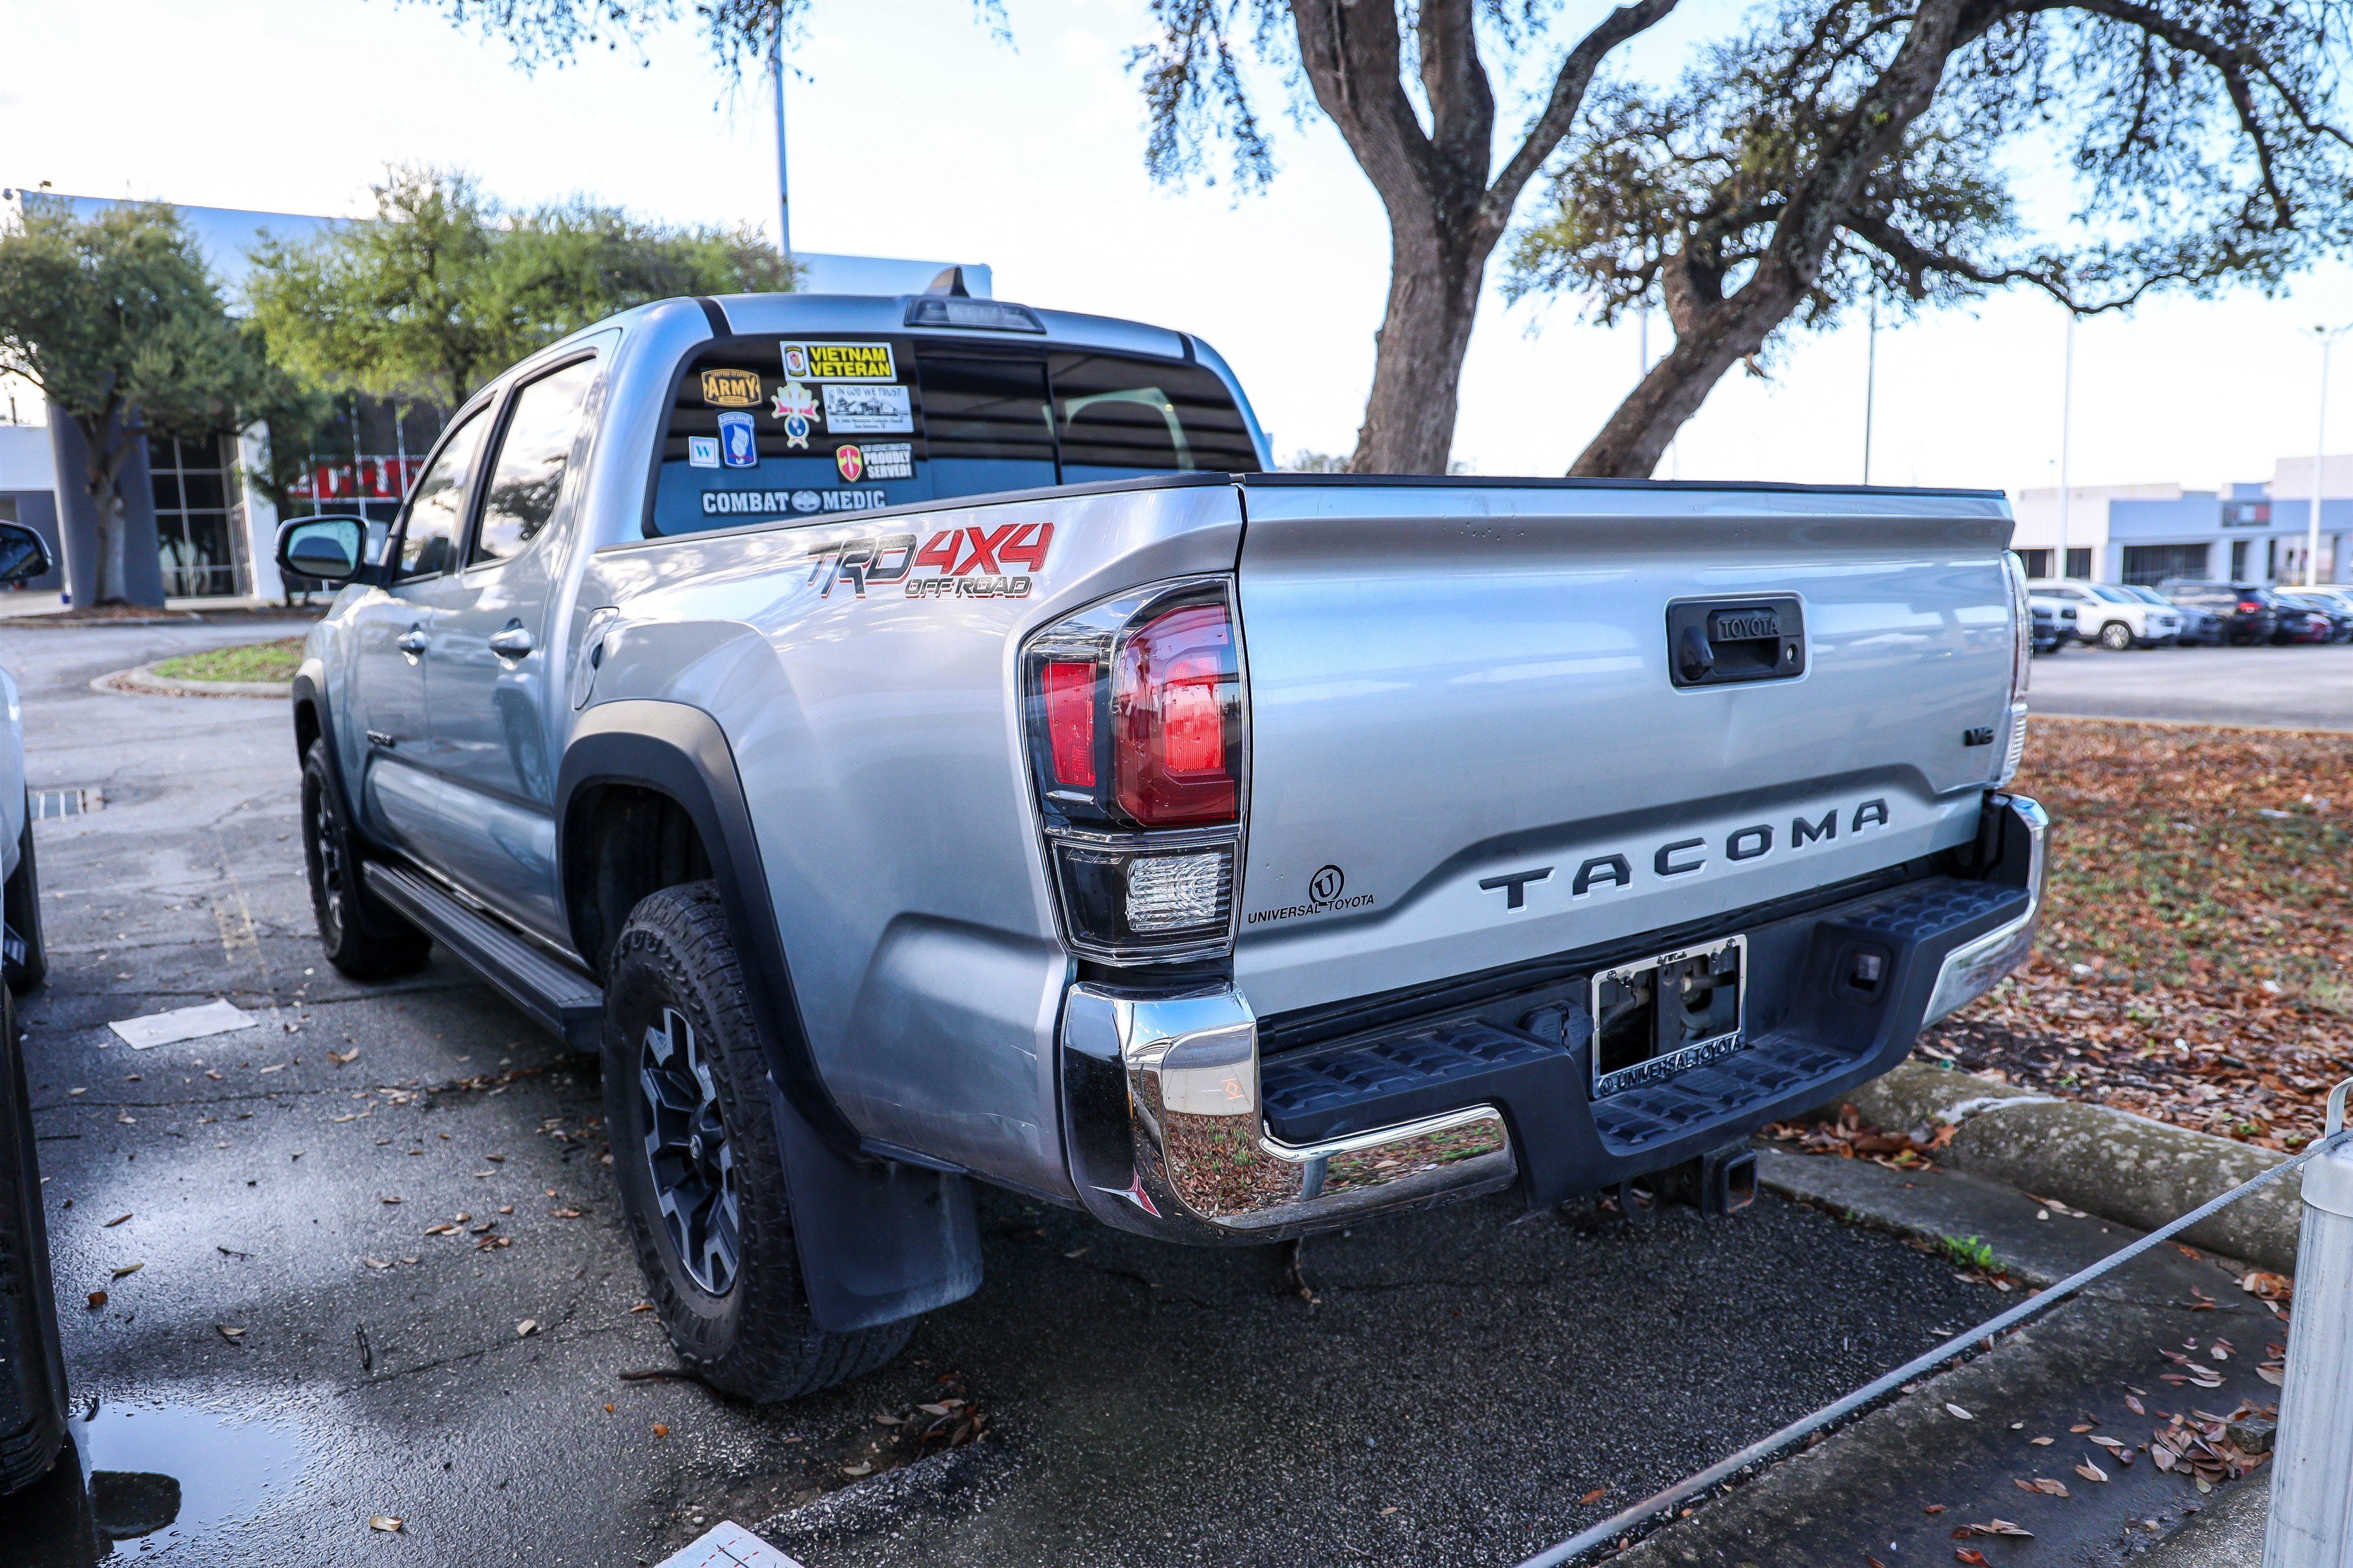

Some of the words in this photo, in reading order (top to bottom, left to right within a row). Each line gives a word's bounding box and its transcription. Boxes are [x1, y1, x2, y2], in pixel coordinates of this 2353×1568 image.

[809, 346, 887, 361] VIETNAM
[810, 362, 890, 376] VETERAN
[708, 376, 756, 399] ARMY
[836, 387, 844, 395] IN
[846, 387, 861, 396] GOD
[864, 387, 876, 396] WE
[878, 387, 902, 396] TRUST
[695, 445, 712, 458] W
[863, 450, 911, 466] PROUDLY
[703, 492, 789, 514] COMBAT
[822, 490, 886, 511] MEDIC
[806, 534, 918, 599] TRD
[913, 522, 1055, 577] 4X4
[904, 577, 955, 598] OFF
[956, 576, 1033, 598] ROAD
[1718, 616, 1780, 638] TOYOTA
[1479, 798, 1891, 914] TACOMA
[1248, 903, 1321, 924] UNIVERSAL
[1326, 894, 1375, 912] TOYOTA
[1617, 1051, 1694, 1090] UNIVERSAL
[1694, 1034, 1742, 1066] TOYOTA
